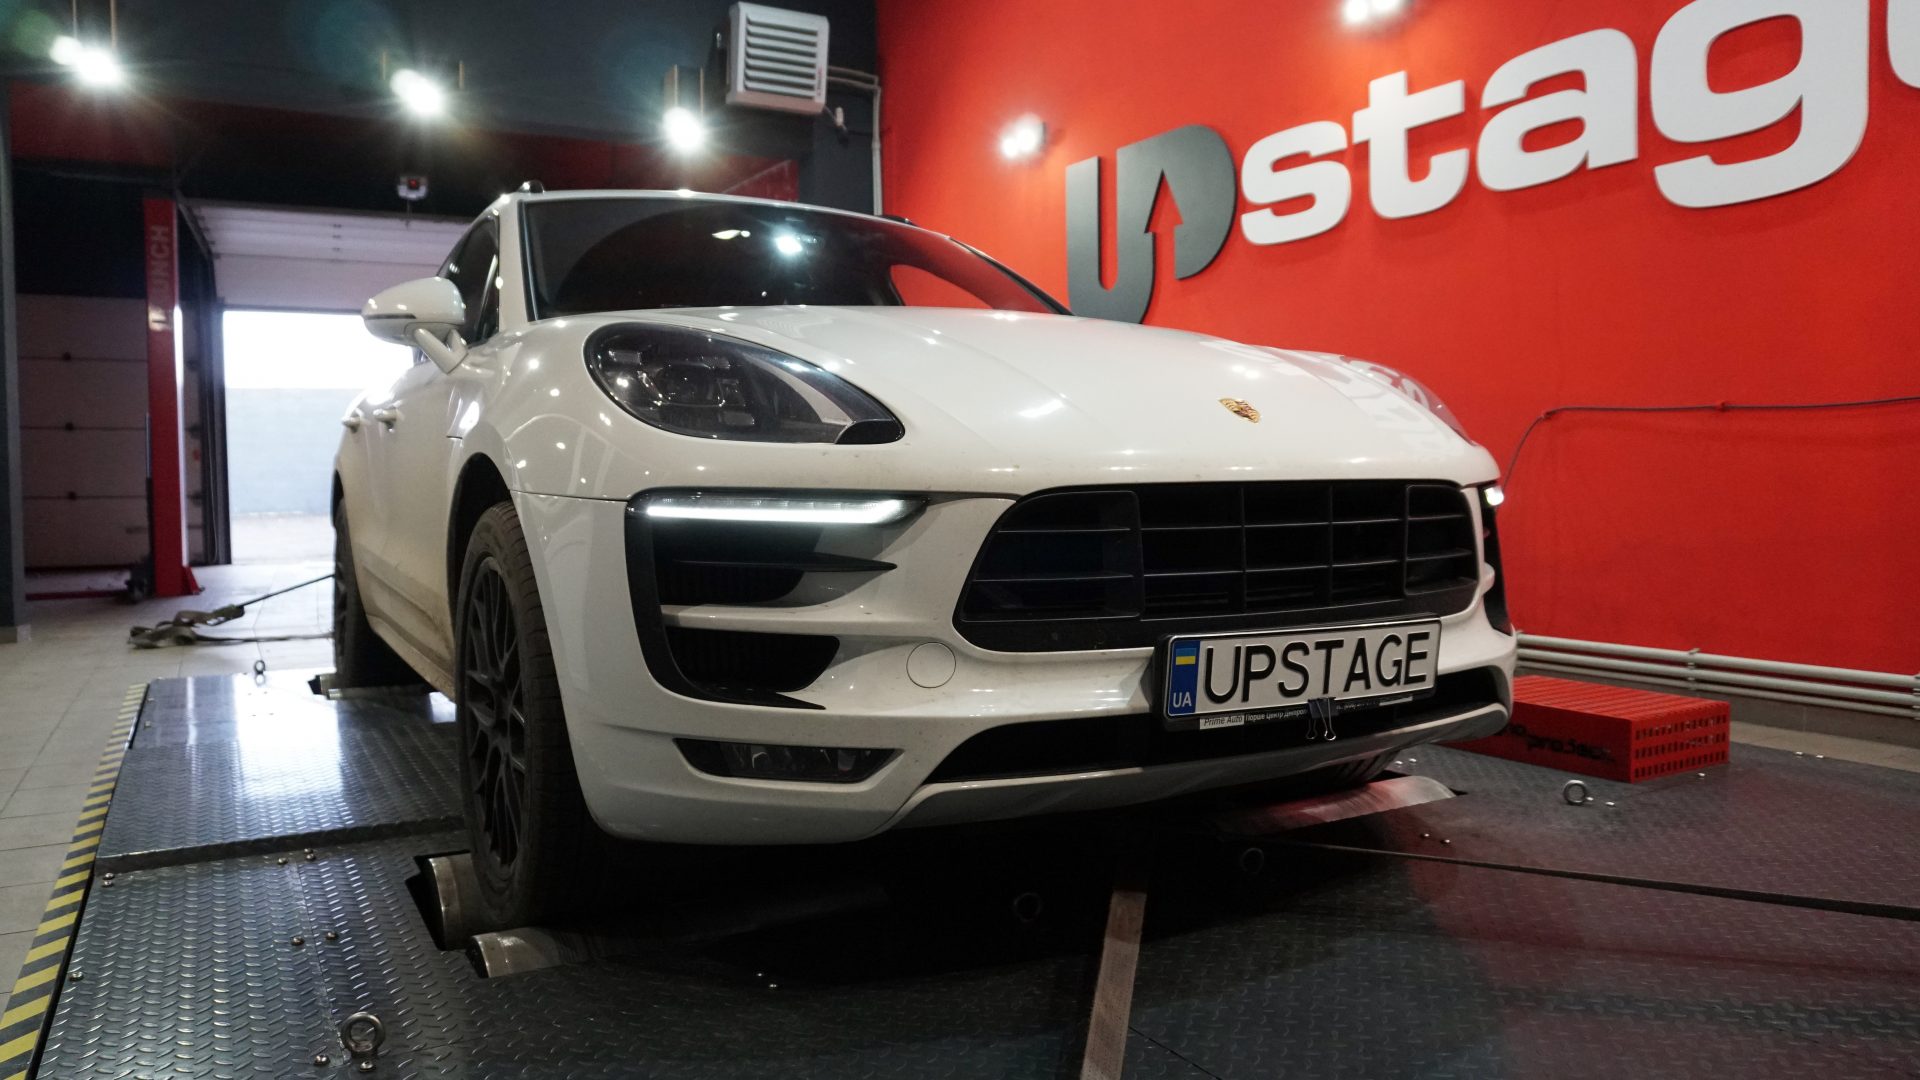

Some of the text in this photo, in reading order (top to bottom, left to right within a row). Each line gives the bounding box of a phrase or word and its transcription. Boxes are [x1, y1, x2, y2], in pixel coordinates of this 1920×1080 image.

[1065, 0, 1920, 322] UPstag
[1203, 631, 1431, 704] UPSTAGE
[1172, 691, 1193, 708] UA
[1203, 715, 1243, 727] Prime Auto
